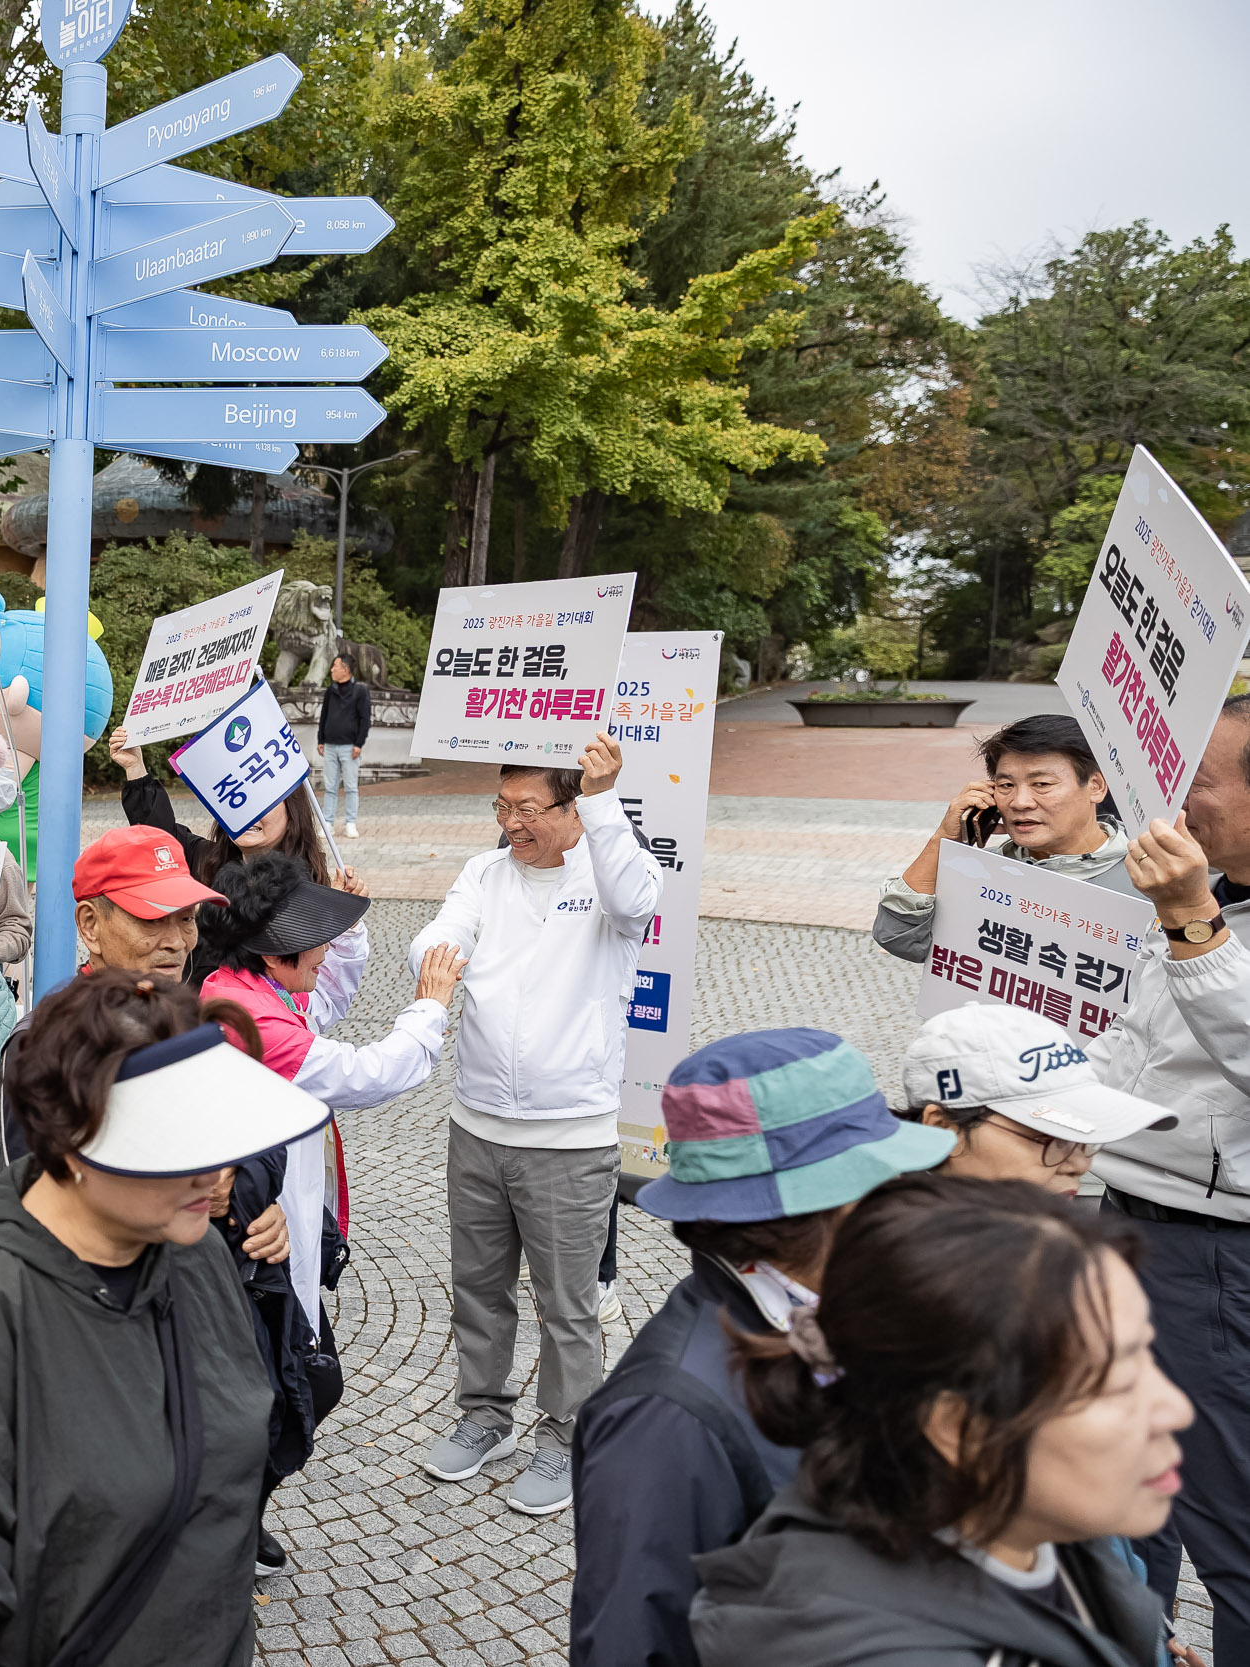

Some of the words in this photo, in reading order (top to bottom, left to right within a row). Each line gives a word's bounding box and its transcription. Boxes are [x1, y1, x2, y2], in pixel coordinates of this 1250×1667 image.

[252, 87, 265, 99] 196
[266, 82, 277, 93] km
[147, 98, 231, 148] Pyongyang
[241, 230, 259, 244] 1,990
[260, 227, 271, 238] km
[326, 220, 350, 231] 8,058
[352, 220, 366, 230] km
[135, 237, 227, 282] Ulaanbaatar
[211, 342, 300, 362] Moscow
[224, 403, 297, 428] Beijing
[325, 410, 342, 420] 954
[344, 410, 357, 419] km
[1135, 516, 1151, 545] 2025
[1150, 535, 1175, 580] 광진가족
[1174, 569, 1194, 608] 가을길
[1190, 594, 1216, 644] 걷기대회
[463, 618, 485, 629] 2025
[488, 614, 523, 629] 광진가족
[526, 612, 553, 628] 가을길
[556, 611, 594, 626] 걷기대회
[1099, 543, 1144, 628] 오늘도
[1135, 596, 1159, 652] 한
[1149, 618, 1185, 707] 걸음,
[145, 657, 169, 683] 매일
[196, 625, 258, 669] 건강해지자!
[165, 632, 181, 645] 2025
[433, 647, 494, 677] 오늘도
[497, 646, 518, 676] 한
[522, 644, 567, 680] 걸음,
[129, 684, 175, 717] 걸을수록
[172, 680, 188, 705] 더
[465, 687, 527, 720] 활기찬
[530, 688, 605, 721] 하루로!
[616, 682, 650, 697] 025
[640, 702, 693, 721] 가을길
[1100, 631, 1146, 725] 활기찬
[1136, 696, 1186, 806] 하루로!
[213, 722, 303, 809] 중곡3동
[979, 885, 1013, 907] 2025
[1018, 898, 1072, 929] 광진가족
[1077, 917, 1120, 946] 가을길
[977, 918, 1033, 967] 생활
[1038, 941, 1069, 979] 속
[930, 944, 984, 992] 밝은
[987, 967, 1073, 1028] 미래를
[1079, 1000, 1117, 1040] 만
[634, 1004, 662, 1020] 광진!
[936, 1068, 963, 1100] FJ
